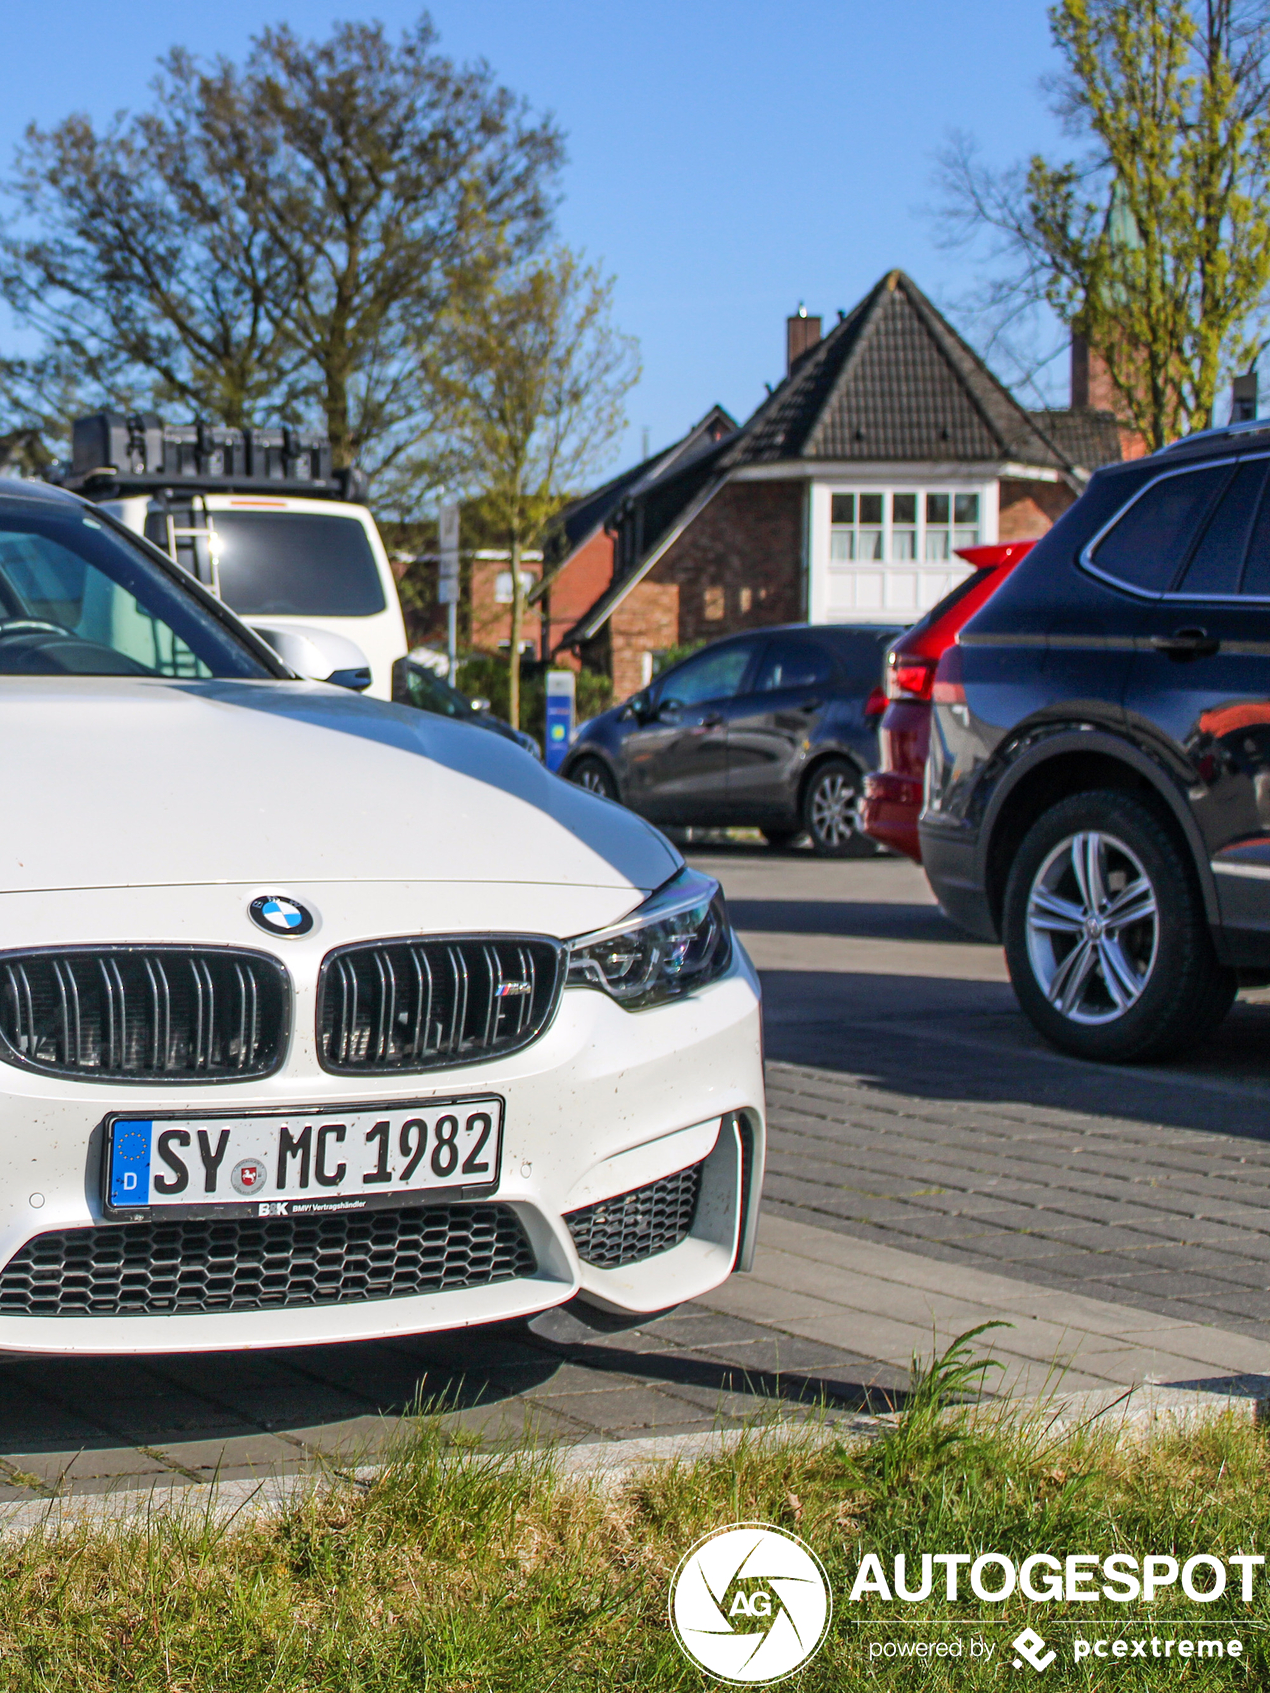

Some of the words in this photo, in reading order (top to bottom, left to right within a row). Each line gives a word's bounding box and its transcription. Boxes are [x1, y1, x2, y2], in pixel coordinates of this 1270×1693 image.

[154, 1128, 230, 1195] SY
[276, 1124, 347, 1190] MC
[363, 1112, 492, 1185] 1982
[124, 1172, 137, 1191] D
[313, 1200, 367, 1212] Vertragshändler
